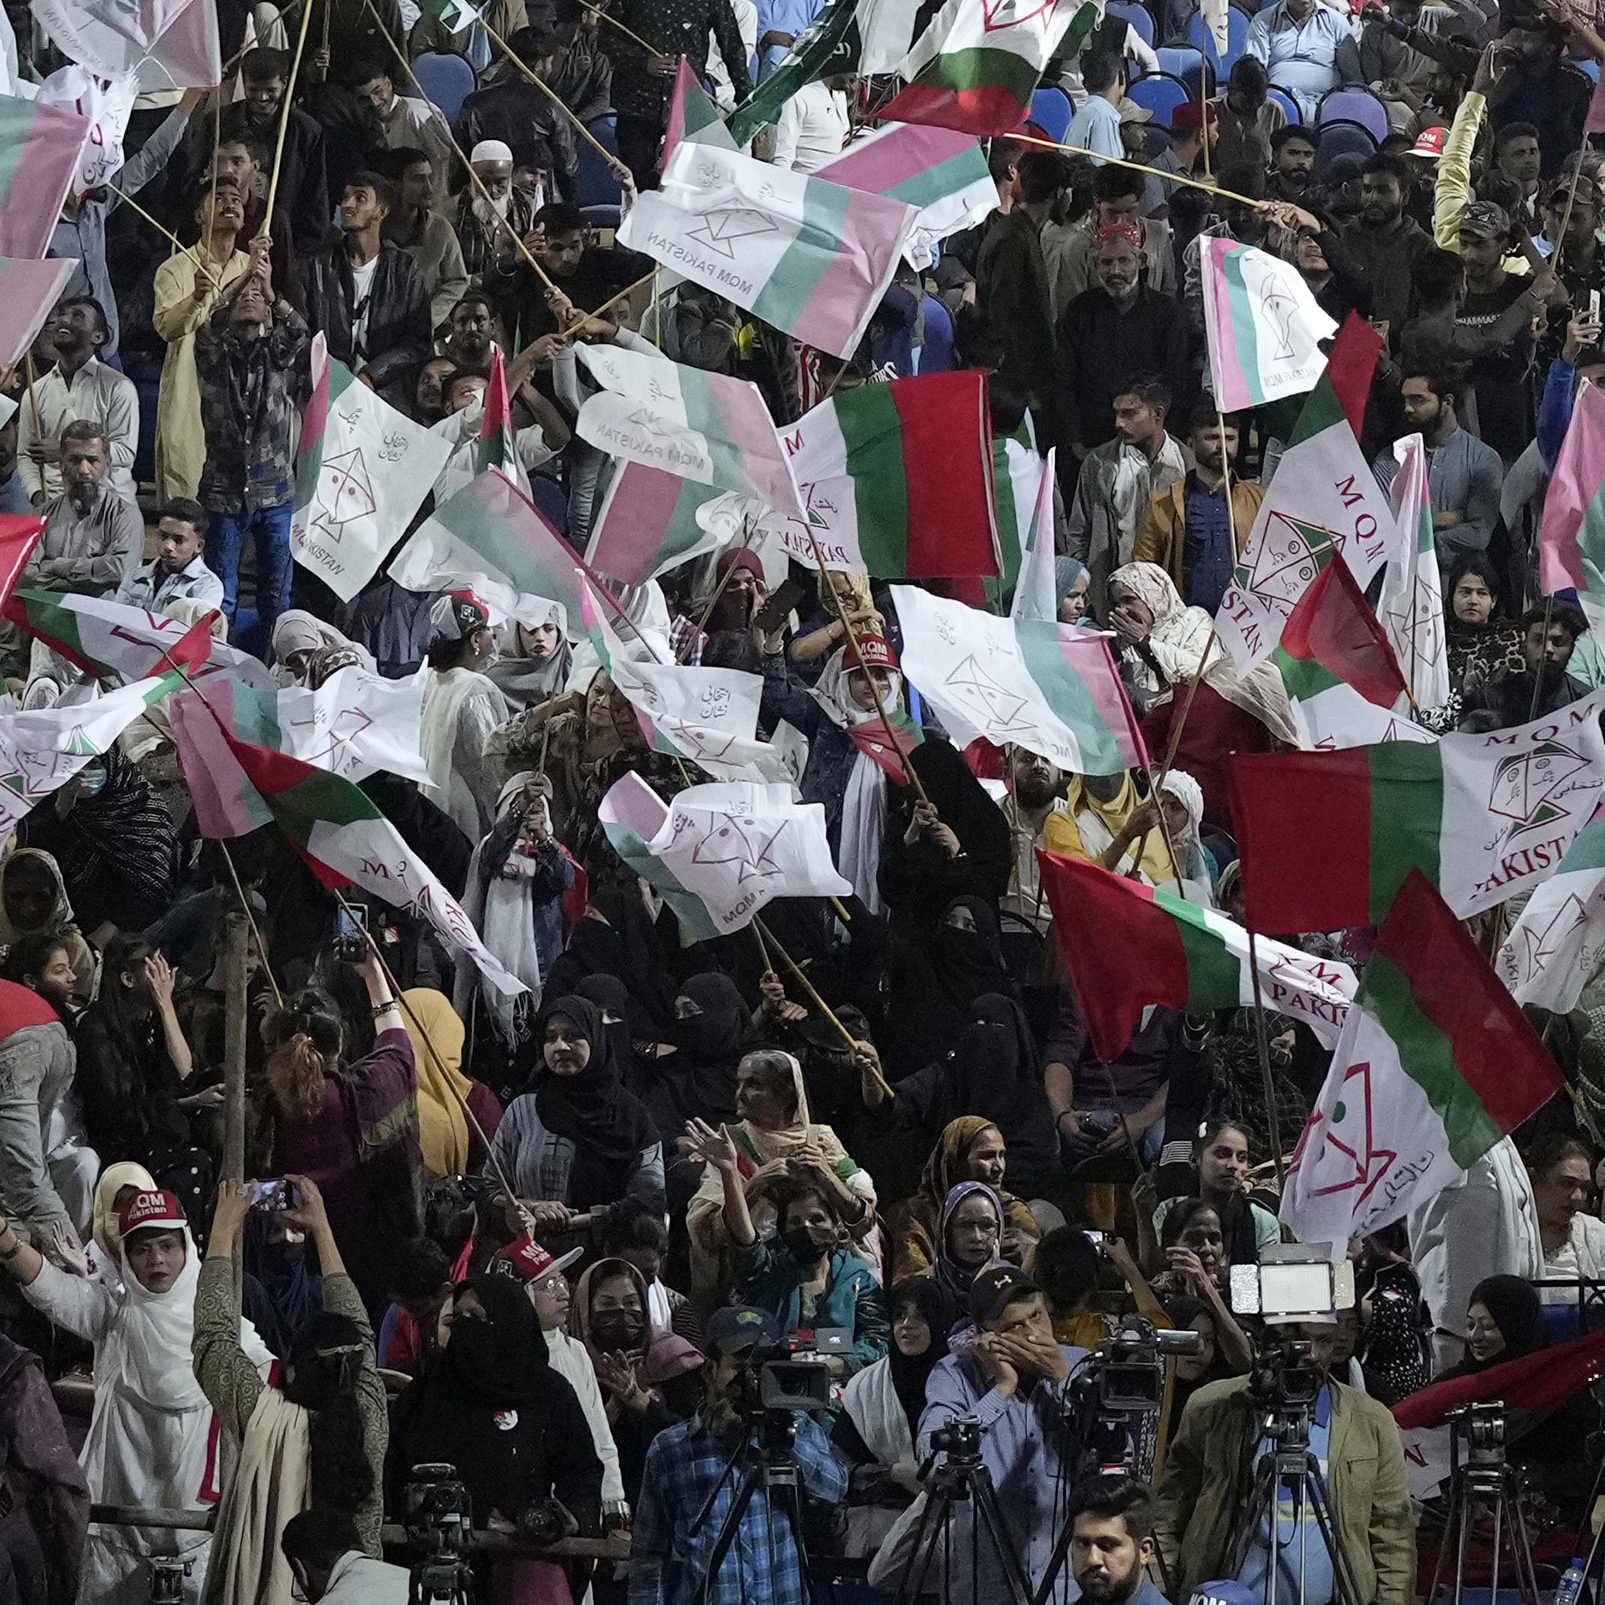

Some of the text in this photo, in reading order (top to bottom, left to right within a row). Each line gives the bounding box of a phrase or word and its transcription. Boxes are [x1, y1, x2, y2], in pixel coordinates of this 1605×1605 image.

[1334, 473, 1386, 564] MQM
[1223, 591, 1264, 658] STAN
[1485, 701, 1598, 748] MQM
[1474, 836, 1566, 899] AKIST
[1500, 943, 1520, 994] PAKIS
